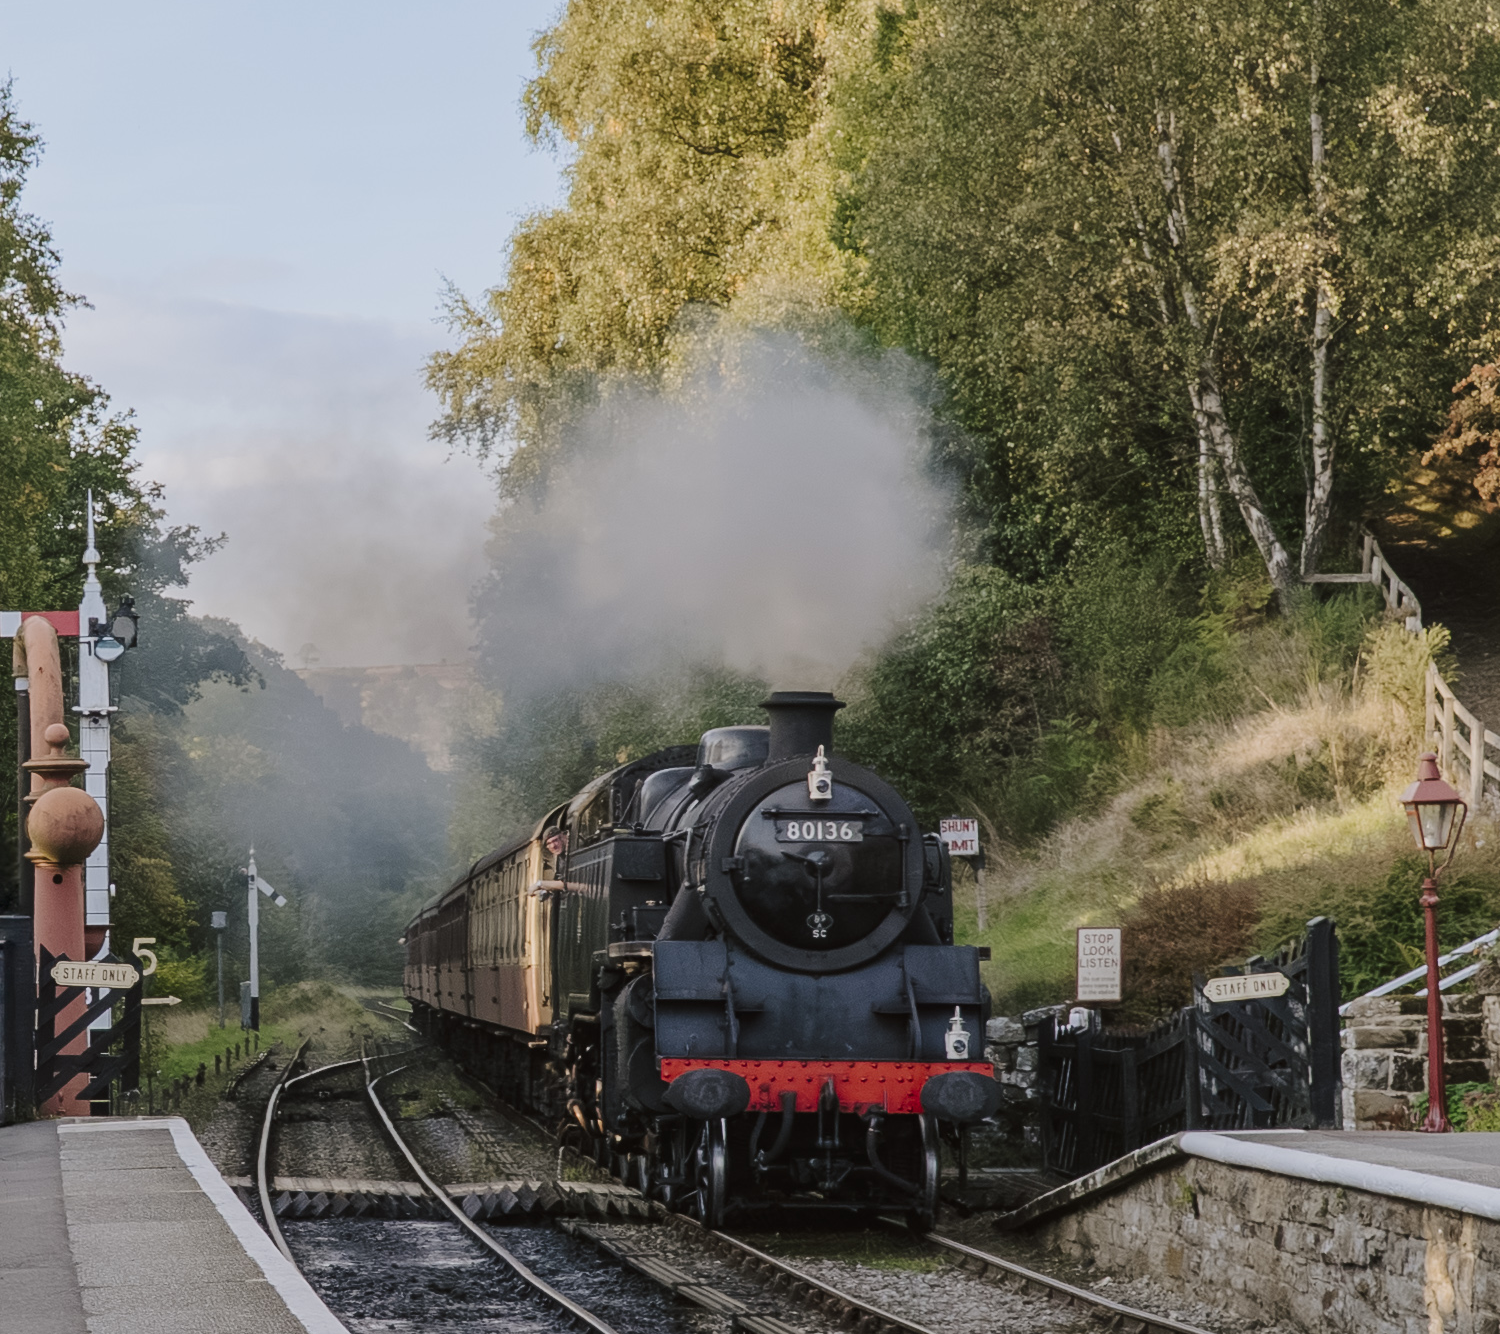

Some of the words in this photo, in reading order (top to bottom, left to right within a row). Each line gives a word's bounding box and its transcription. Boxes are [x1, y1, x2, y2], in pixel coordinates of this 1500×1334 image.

[786, 821, 853, 840] 80136
[941, 819, 976, 833] SHUNT
[949, 839, 975, 851] IMIT
[812, 929, 828, 938] SC
[1084, 933, 1114, 944] STOP
[132, 937, 158, 976] 5
[1080, 958, 1118, 968] LISTEN
[63, 968, 96, 980] STAFF
[102, 969, 127, 982] ONLY
[1215, 982, 1247, 996] STAFF
[1253, 979, 1277, 992] ONLY
